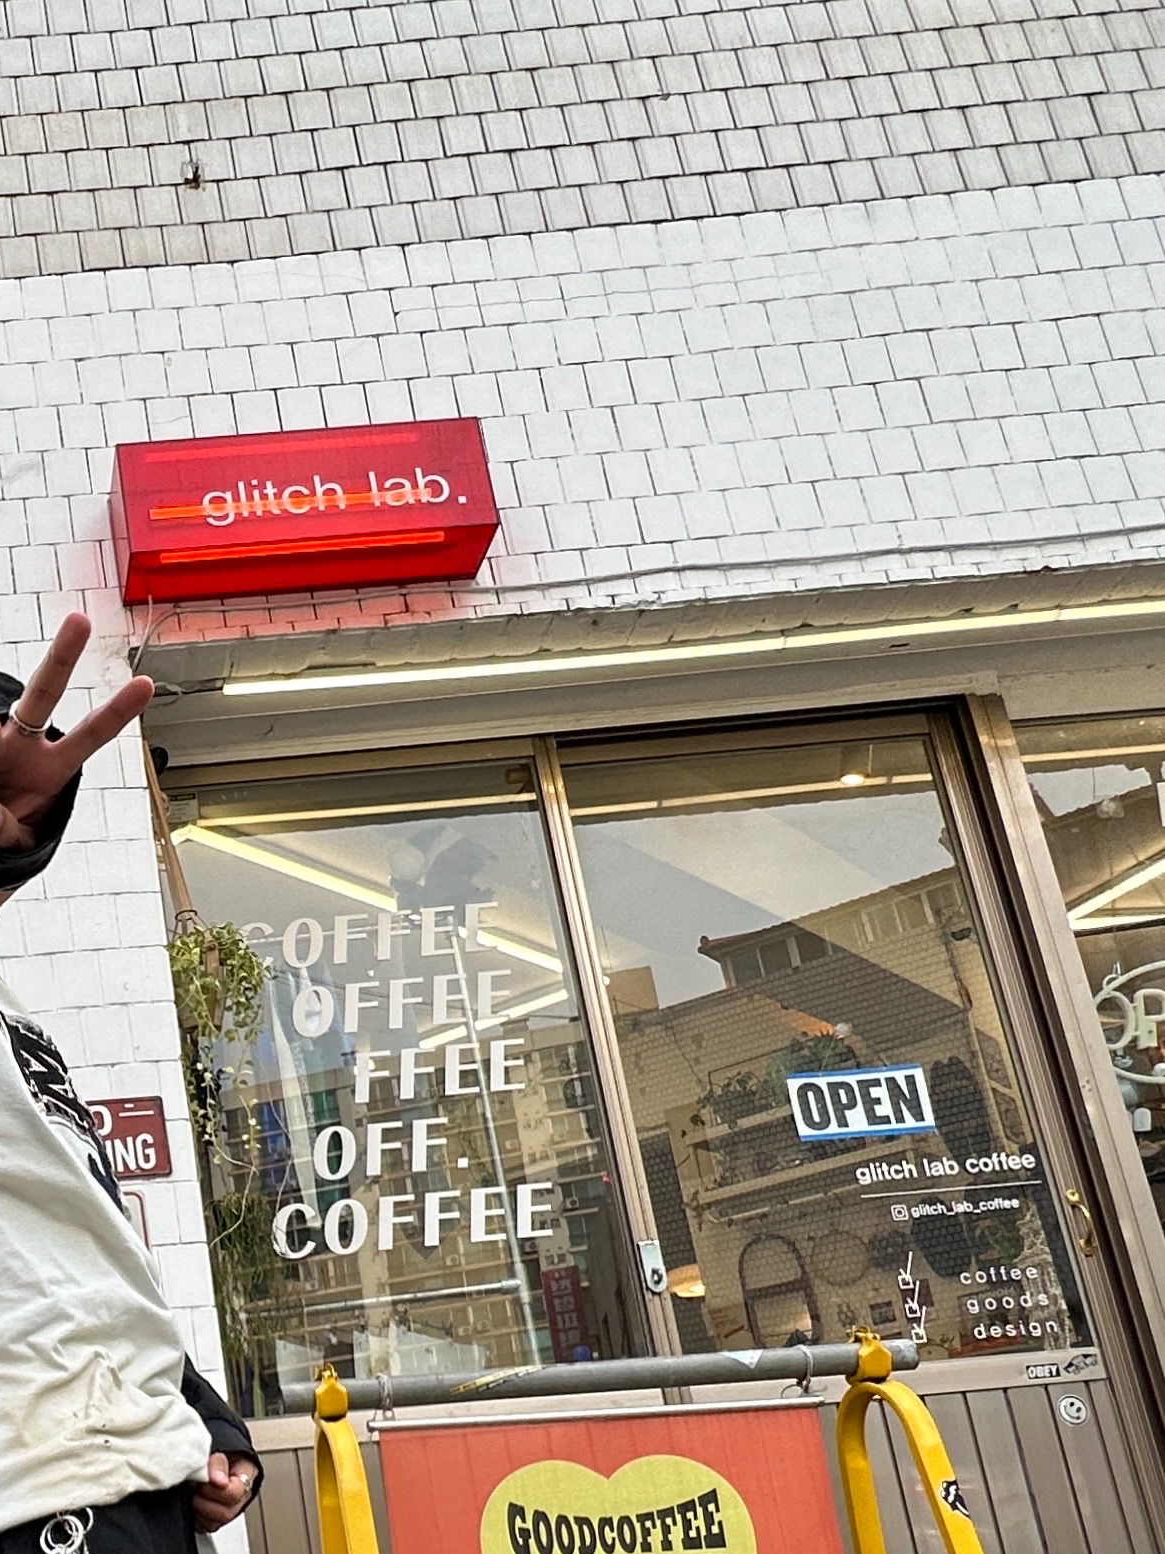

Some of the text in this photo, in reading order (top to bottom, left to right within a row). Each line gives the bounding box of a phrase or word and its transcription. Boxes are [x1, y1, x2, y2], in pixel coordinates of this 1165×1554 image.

[202, 467, 467, 526] glitch lab.
[292, 969, 512, 1038] OFFEE
[354, 1038, 525, 1104] FFEE
[796, 1074, 926, 1131] OPEN
[313, 1117, 469, 1181] OFF.
[855, 1151, 1037, 1185] glitch lab coffee
[272, 1181, 554, 1260] COFFEE
[959, 1265, 1039, 1285] coffee
[966, 1291, 1050, 1314] goods
[973, 1318, 1059, 1340] design
[1027, 1364, 1058, 1379] OBEY
